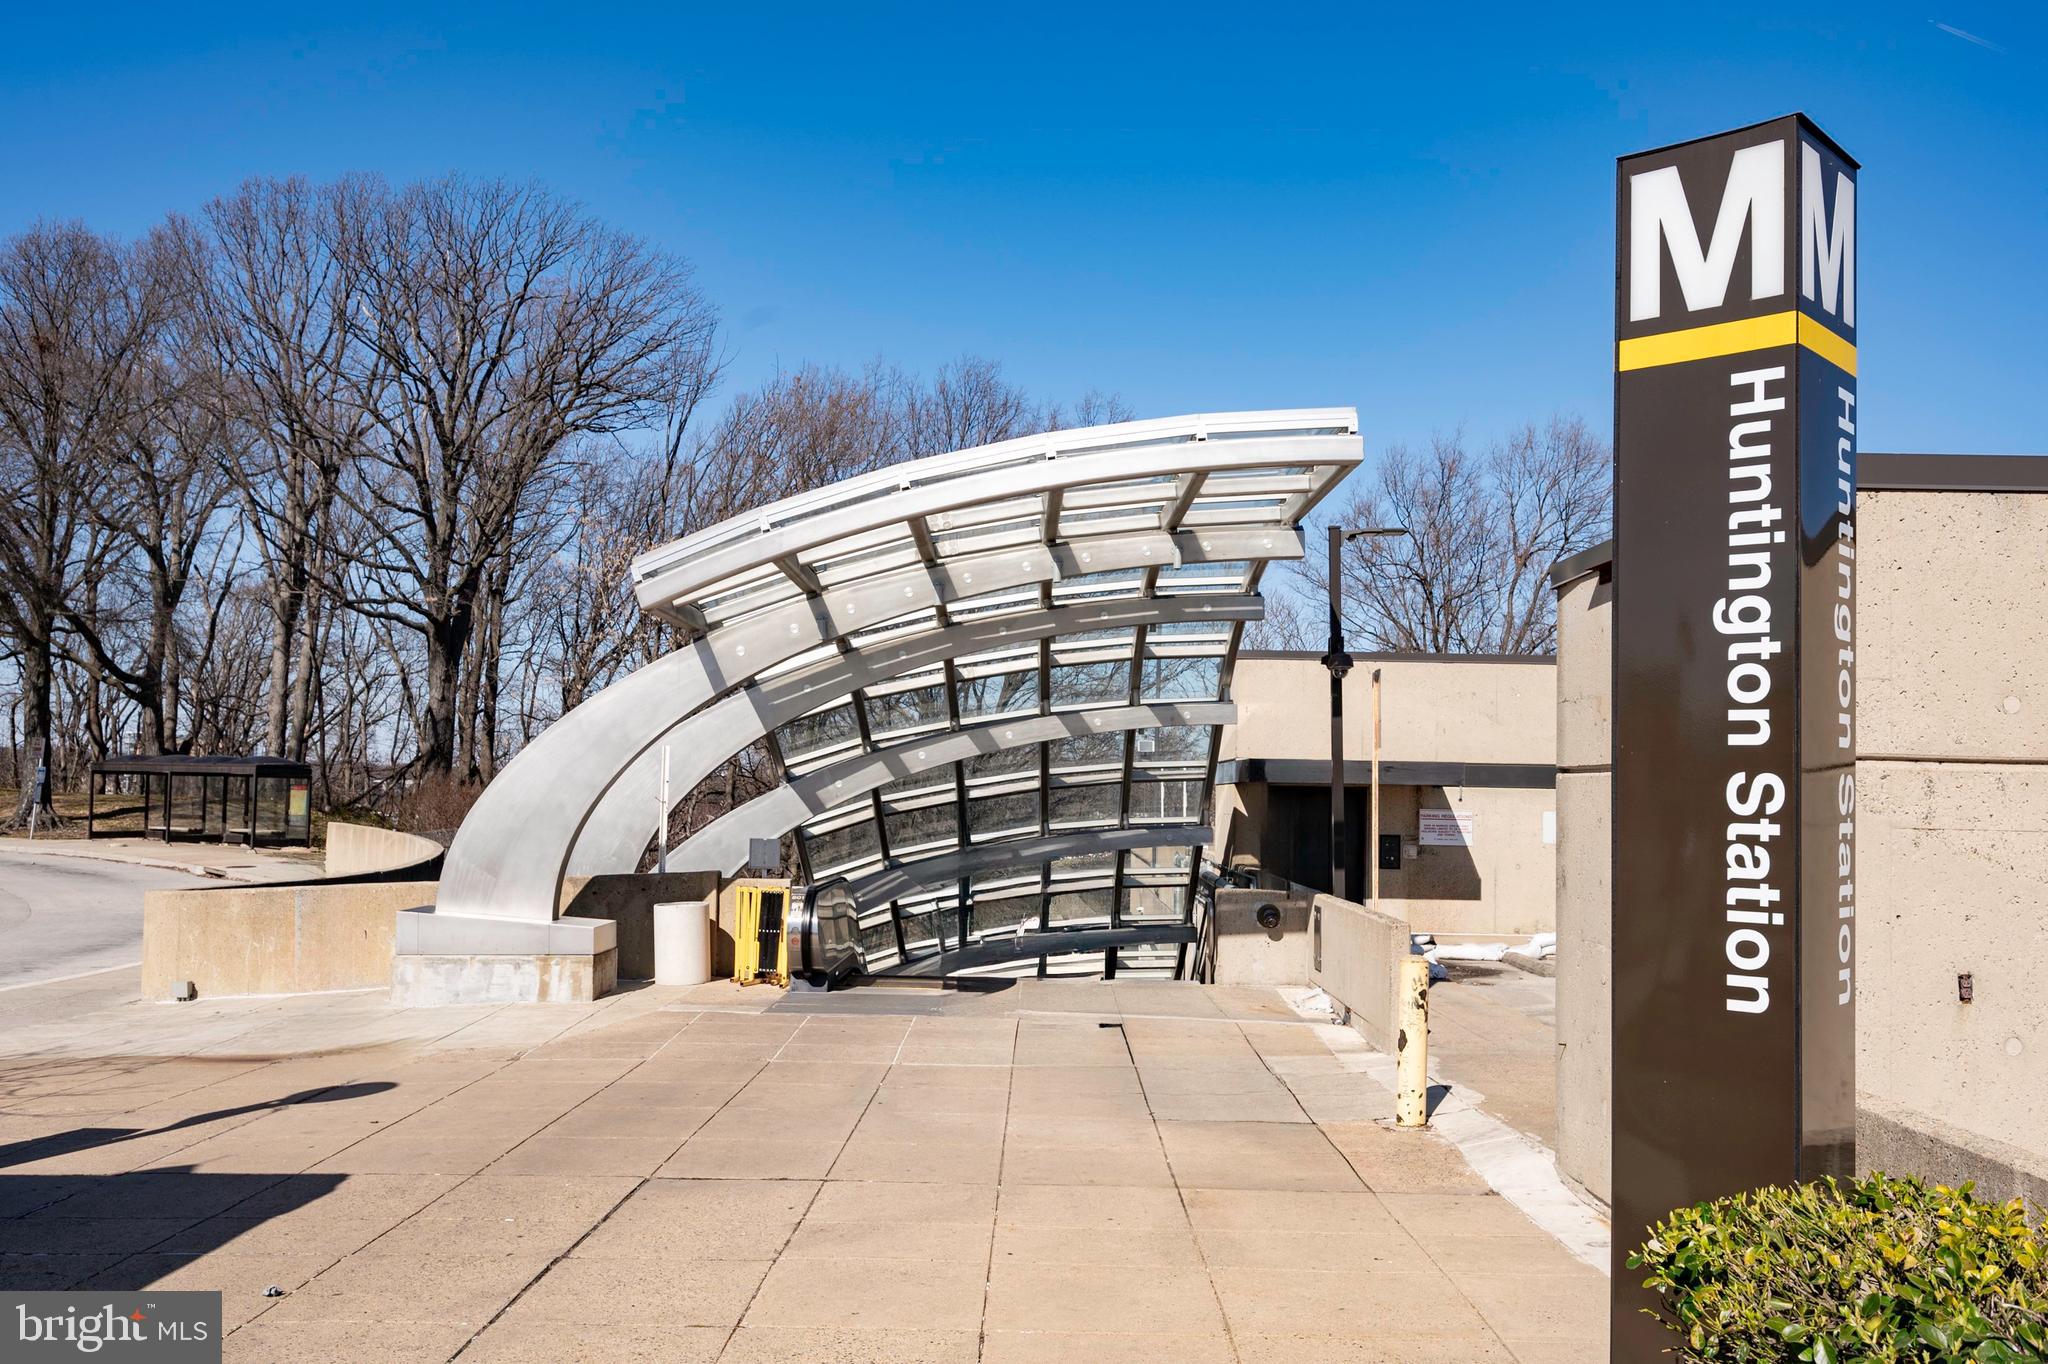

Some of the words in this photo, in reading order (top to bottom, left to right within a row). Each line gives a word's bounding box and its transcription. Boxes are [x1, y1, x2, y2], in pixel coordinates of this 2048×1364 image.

[1630, 139, 1785, 322] M
[1801, 140, 1855, 329] M
[1712, 365, 1786, 747] Huntington
[1833, 385, 1856, 749] Huntington
[1725, 771, 1786, 1014] Station
[1838, 773, 1855, 1006] Station
